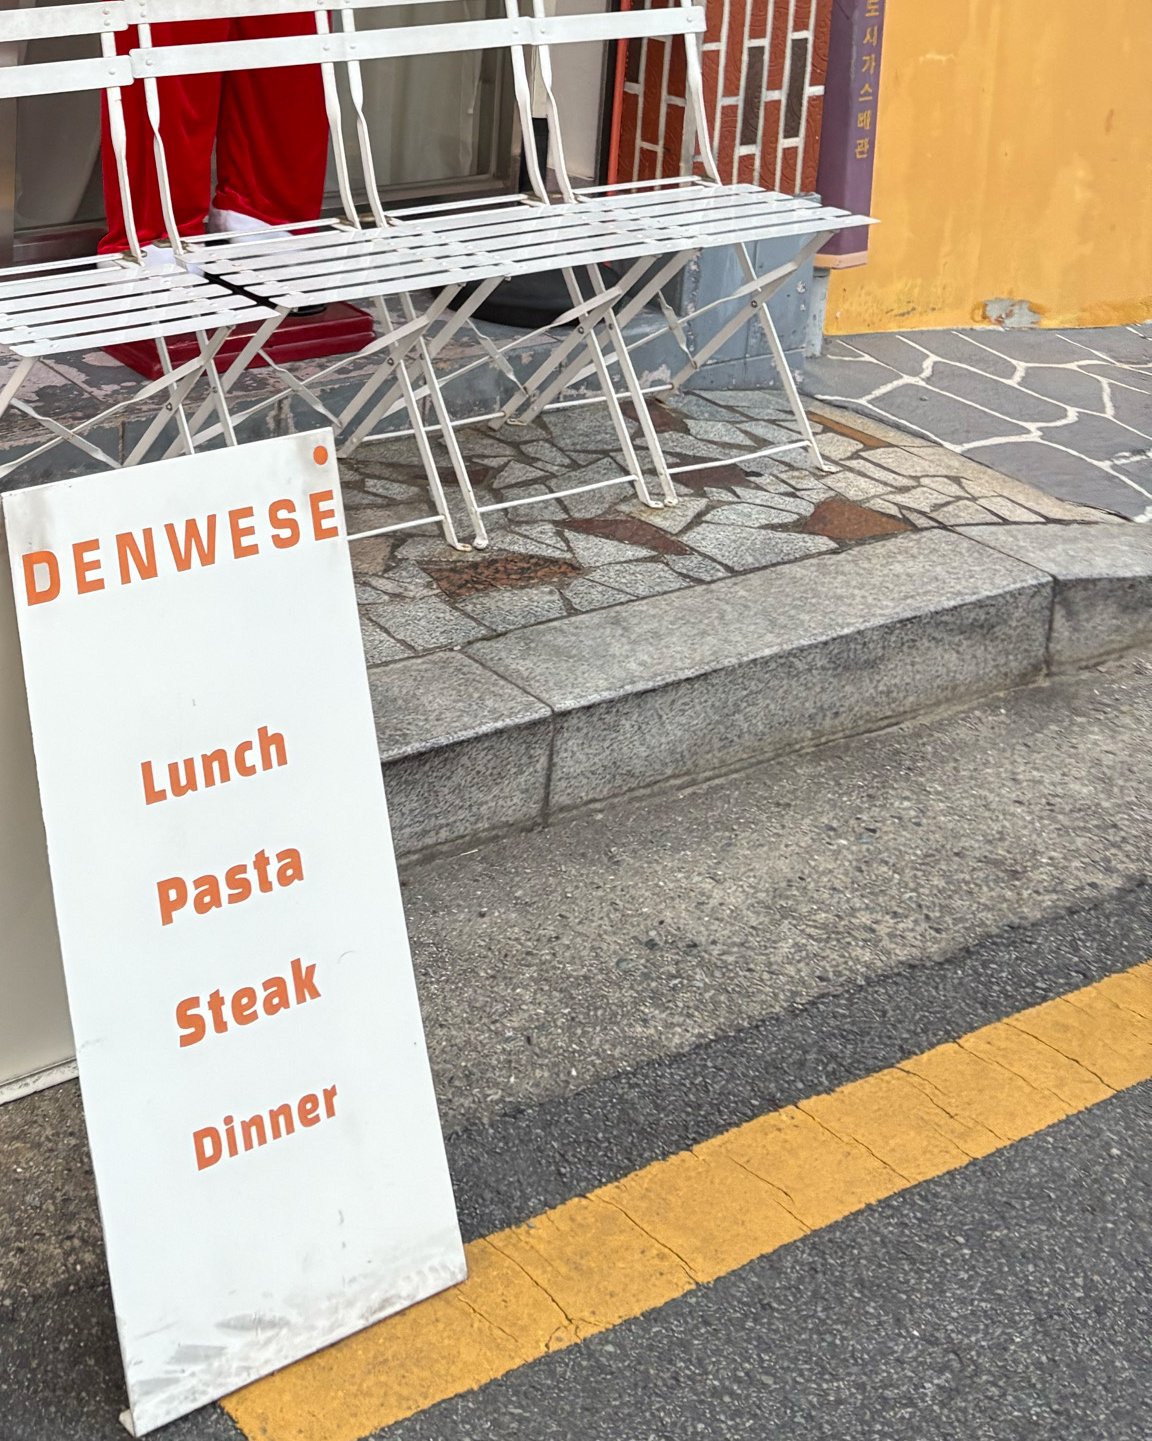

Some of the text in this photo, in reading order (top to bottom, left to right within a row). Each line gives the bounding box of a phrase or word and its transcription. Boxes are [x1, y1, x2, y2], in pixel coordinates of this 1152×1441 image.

[22, 487, 339, 606] DENWESE
[140, 725, 288, 805] Lunch
[157, 845, 305, 926] Pasta
[174, 958, 321, 1048] Steak
[192, 1083, 338, 1171] Dinner
